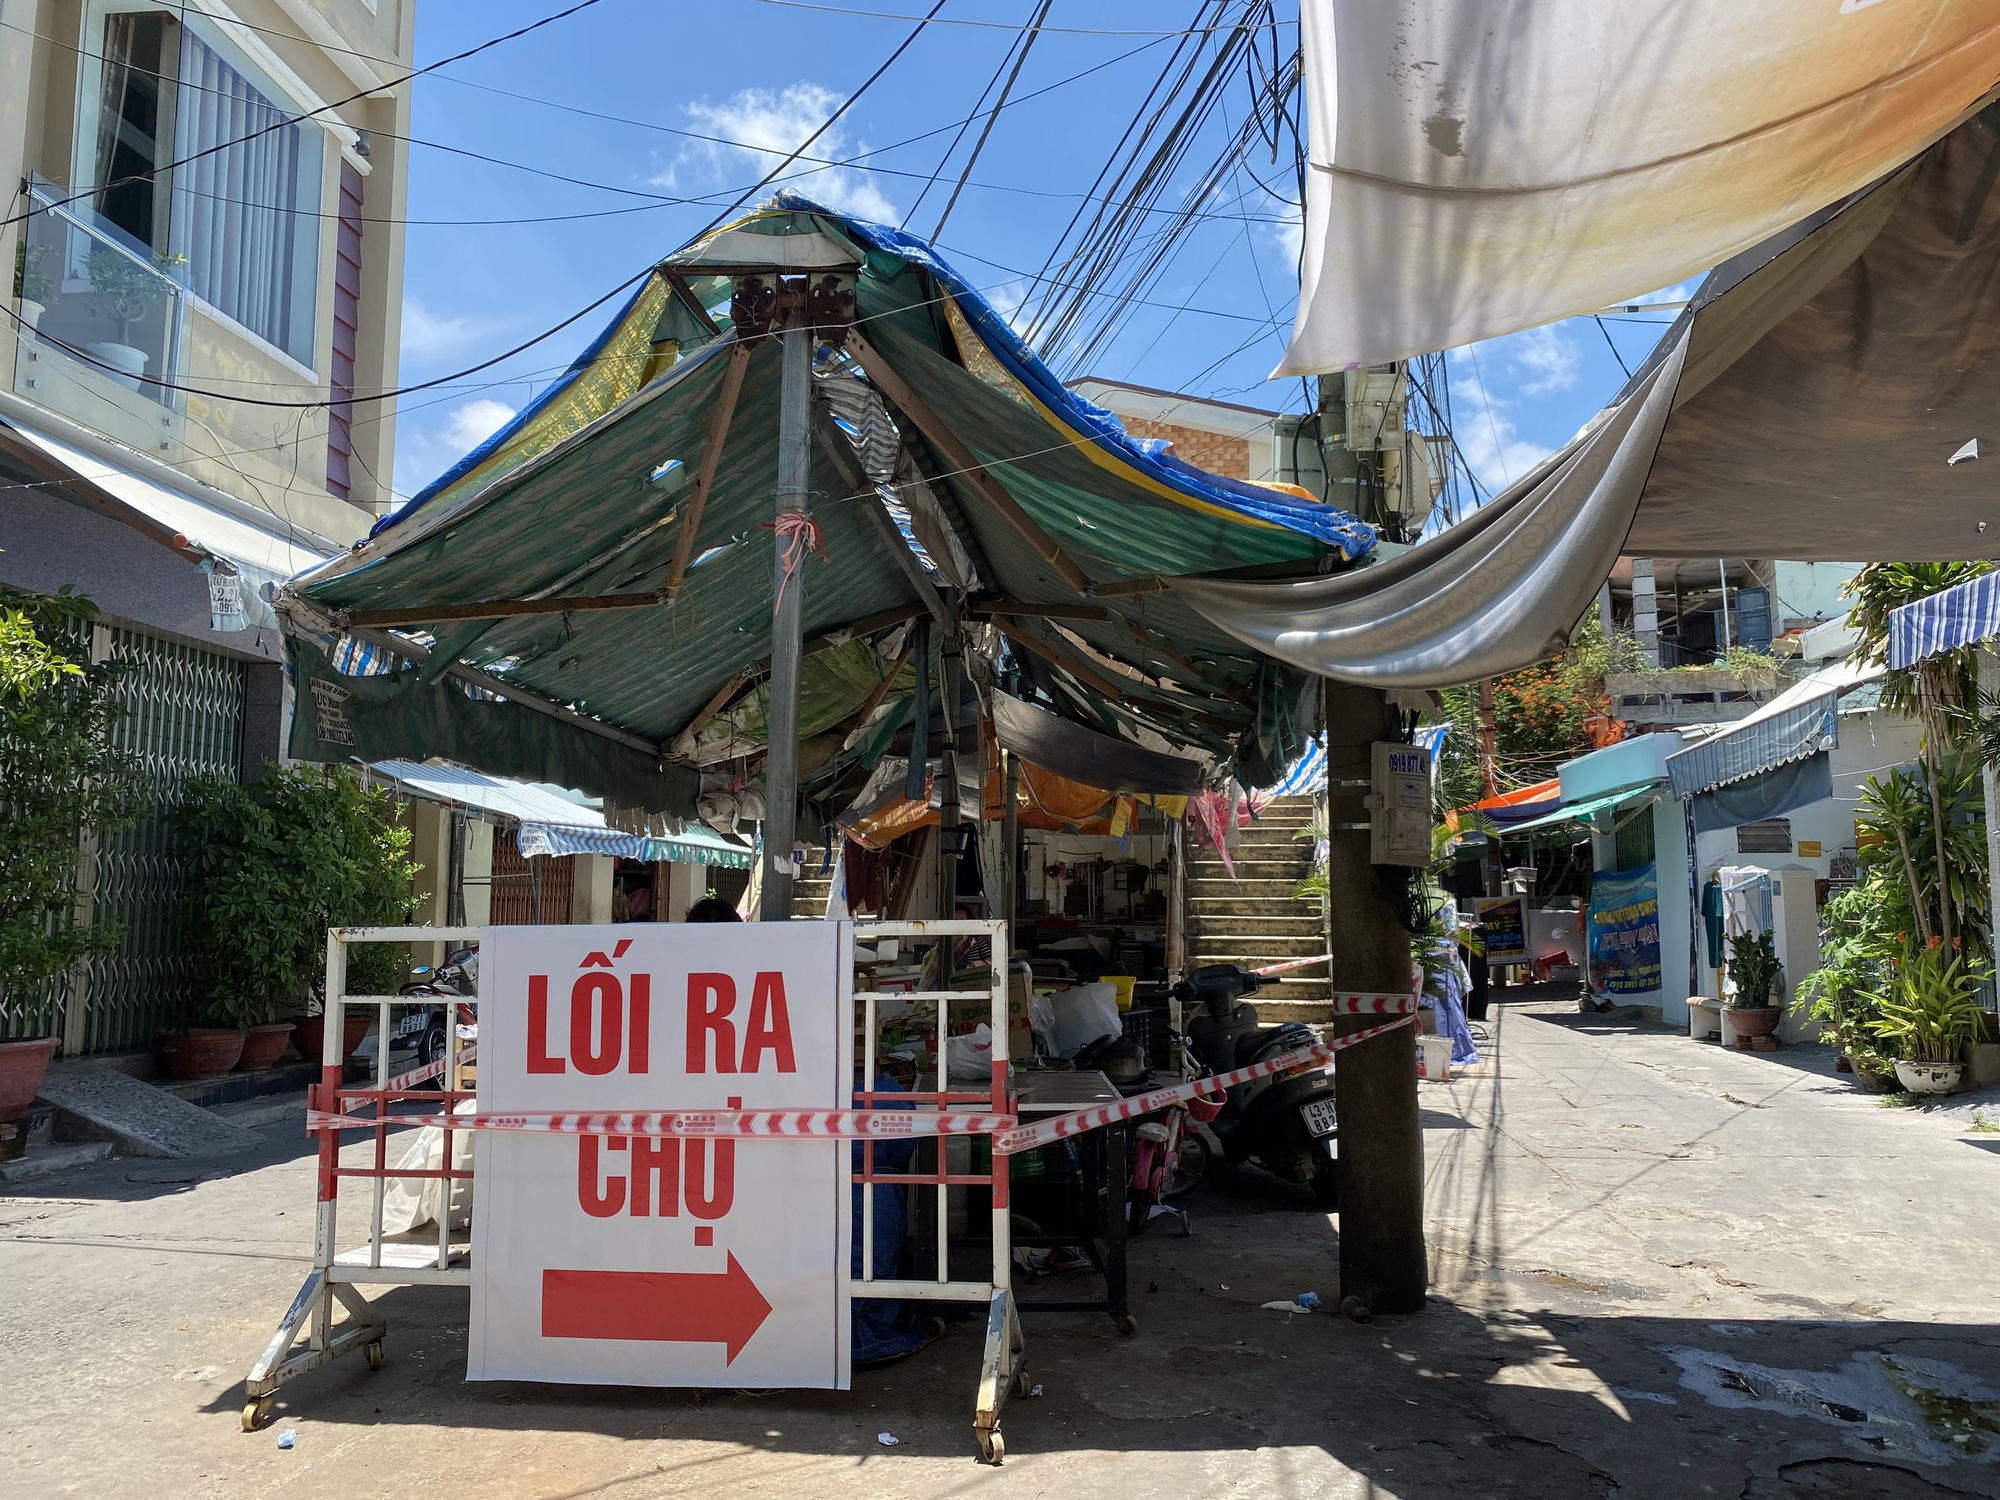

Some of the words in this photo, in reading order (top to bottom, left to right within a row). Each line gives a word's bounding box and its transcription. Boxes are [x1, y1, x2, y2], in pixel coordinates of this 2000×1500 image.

[403, 1022, 421, 1032] 8931
[526, 939, 650, 1075] LỐI
[687, 971, 796, 1074] RA
